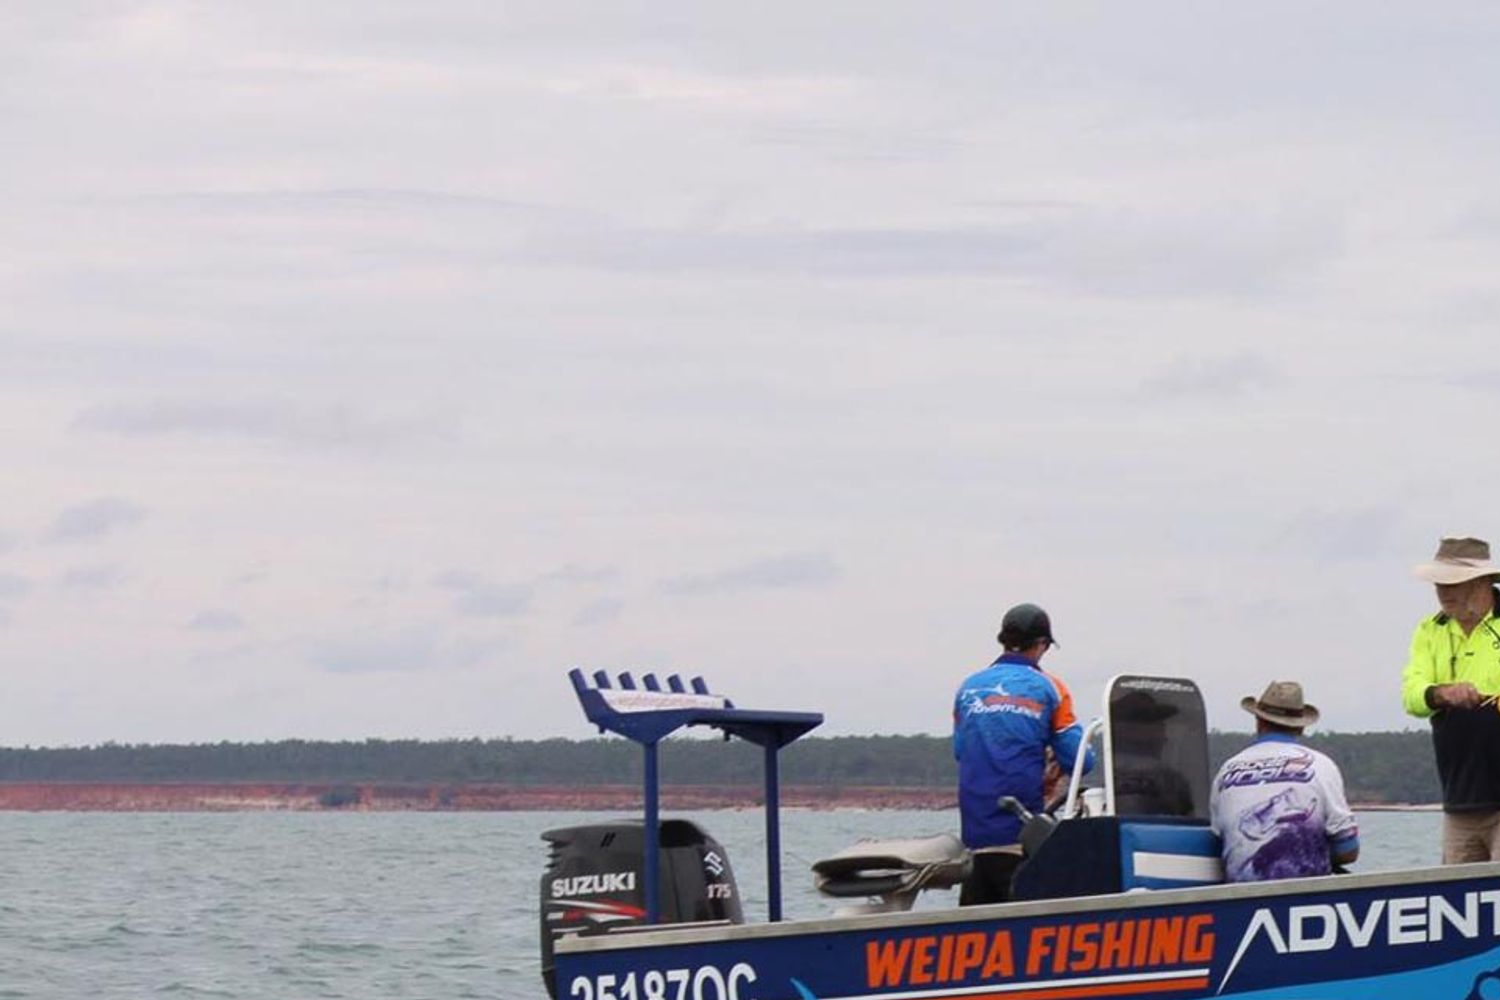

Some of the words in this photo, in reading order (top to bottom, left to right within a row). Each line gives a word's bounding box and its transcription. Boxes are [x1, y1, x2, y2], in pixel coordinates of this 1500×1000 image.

[552, 872, 635, 897] SUZUKI
[707, 883, 731, 898] 175
[867, 931, 1014, 987] WEIPA
[1026, 915, 1214, 974] FISHING
